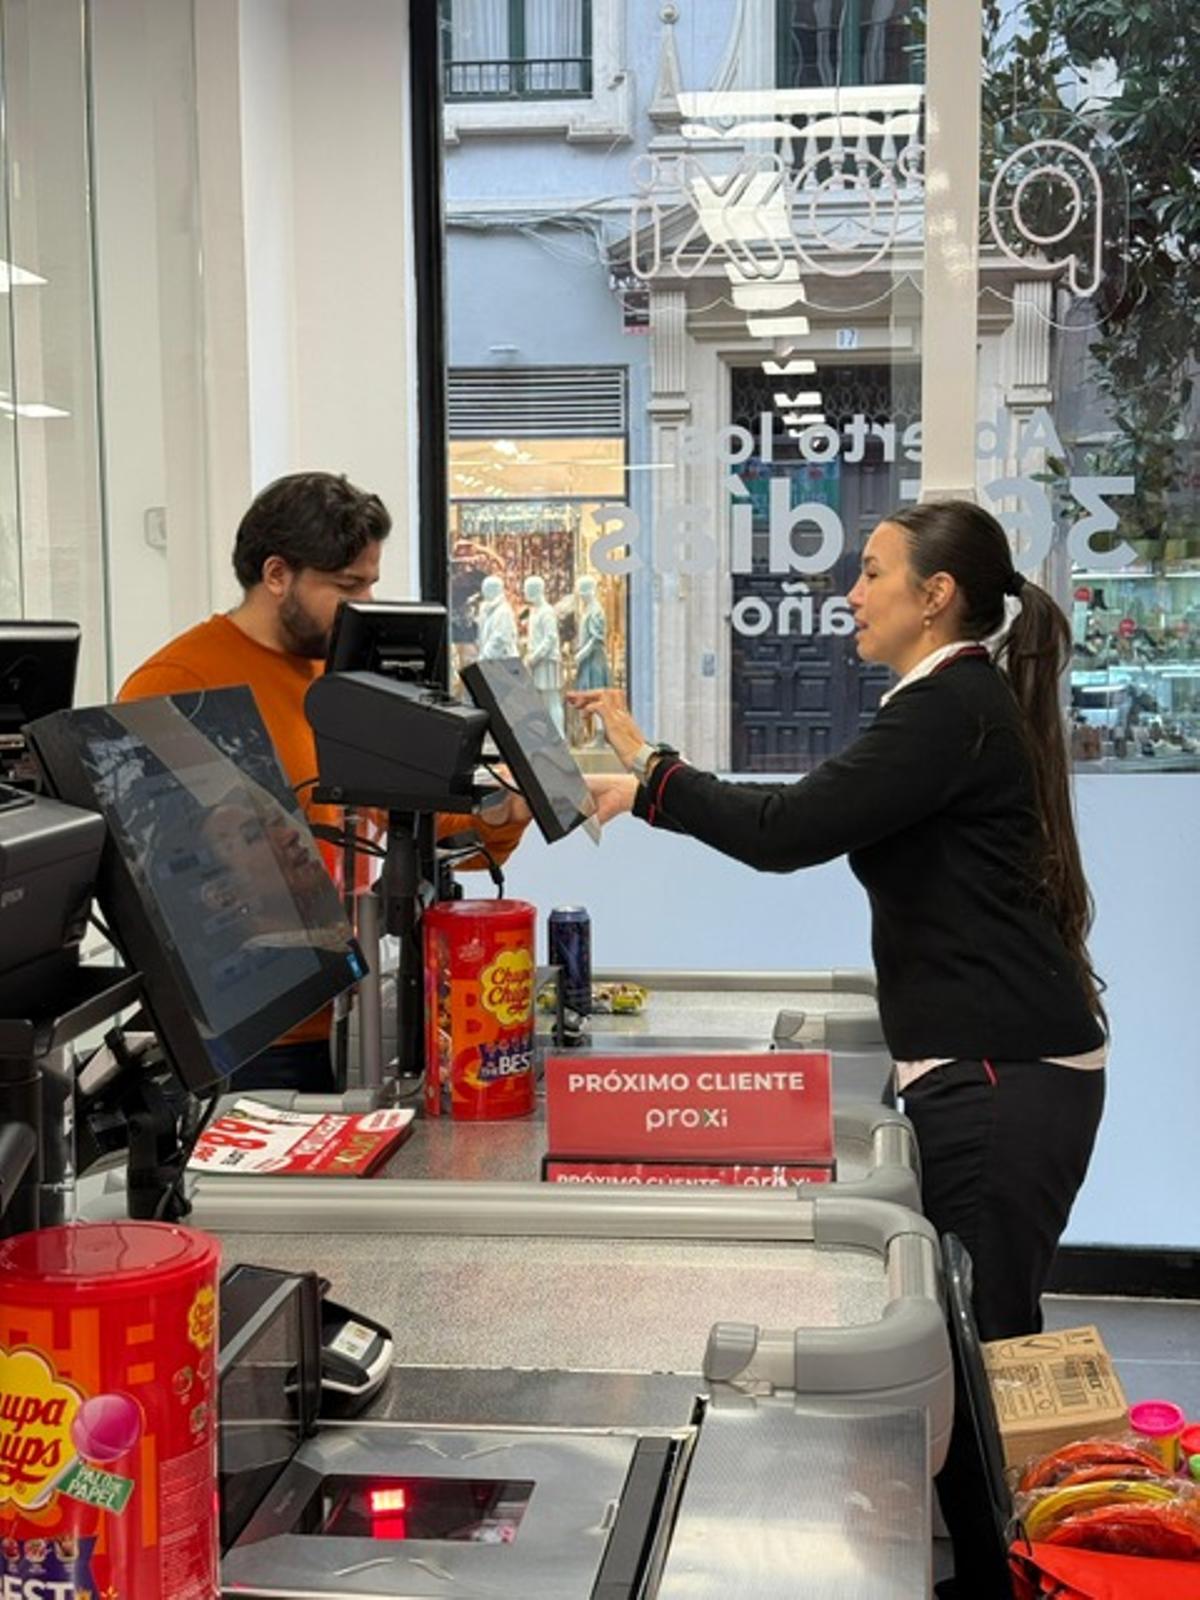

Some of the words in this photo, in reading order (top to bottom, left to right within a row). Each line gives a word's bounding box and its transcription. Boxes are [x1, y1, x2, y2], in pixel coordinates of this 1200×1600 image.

[498, 1051, 532, 1076] BES
[568, 1069, 690, 1093] PRÓXIMO
[696, 1071, 806, 1092] CLIENTE
[645, 1107, 729, 1133] proxi
[0, 1393, 69, 1433] upa
[0, 1433, 62, 1485] ups
[66, 1478, 116, 1508] PAPEL
[0, 1574, 76, 1600] EST
